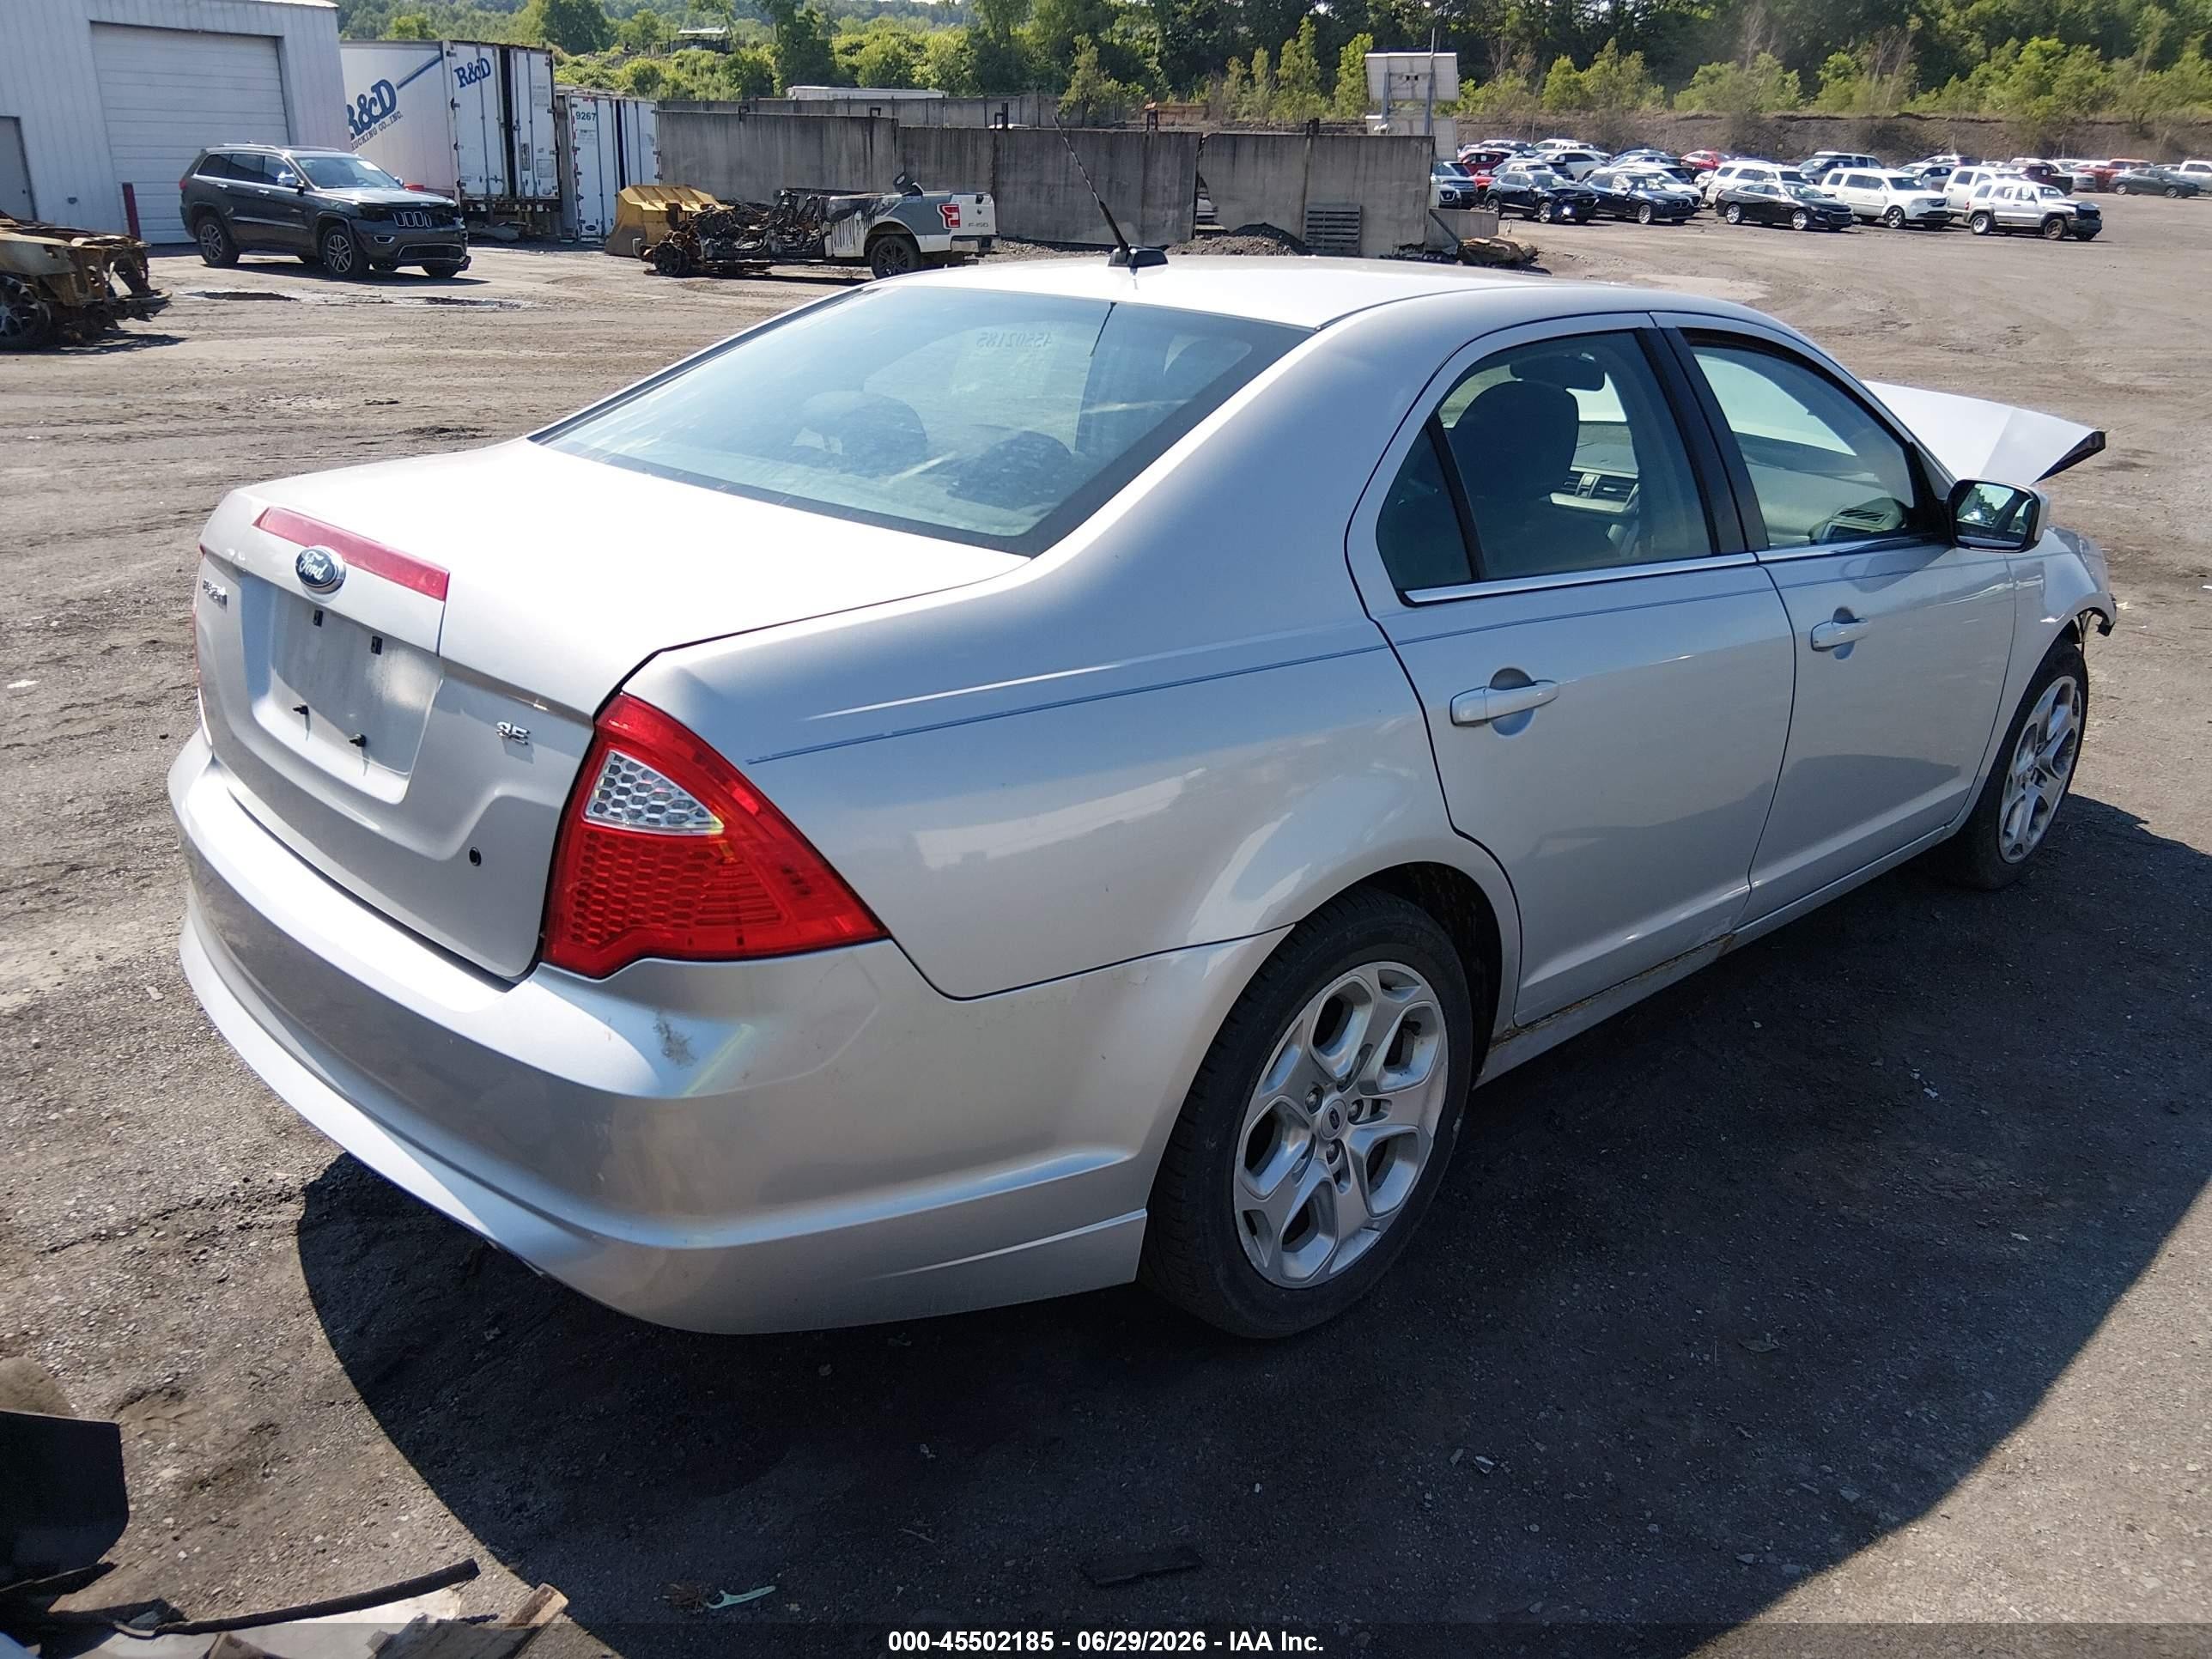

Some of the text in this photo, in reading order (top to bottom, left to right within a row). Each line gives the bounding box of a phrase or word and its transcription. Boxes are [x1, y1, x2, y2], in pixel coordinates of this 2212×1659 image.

[453, 58, 491, 88] R&D
[575, 111, 597, 122] 9267
[299, 550, 329, 581] Ford
